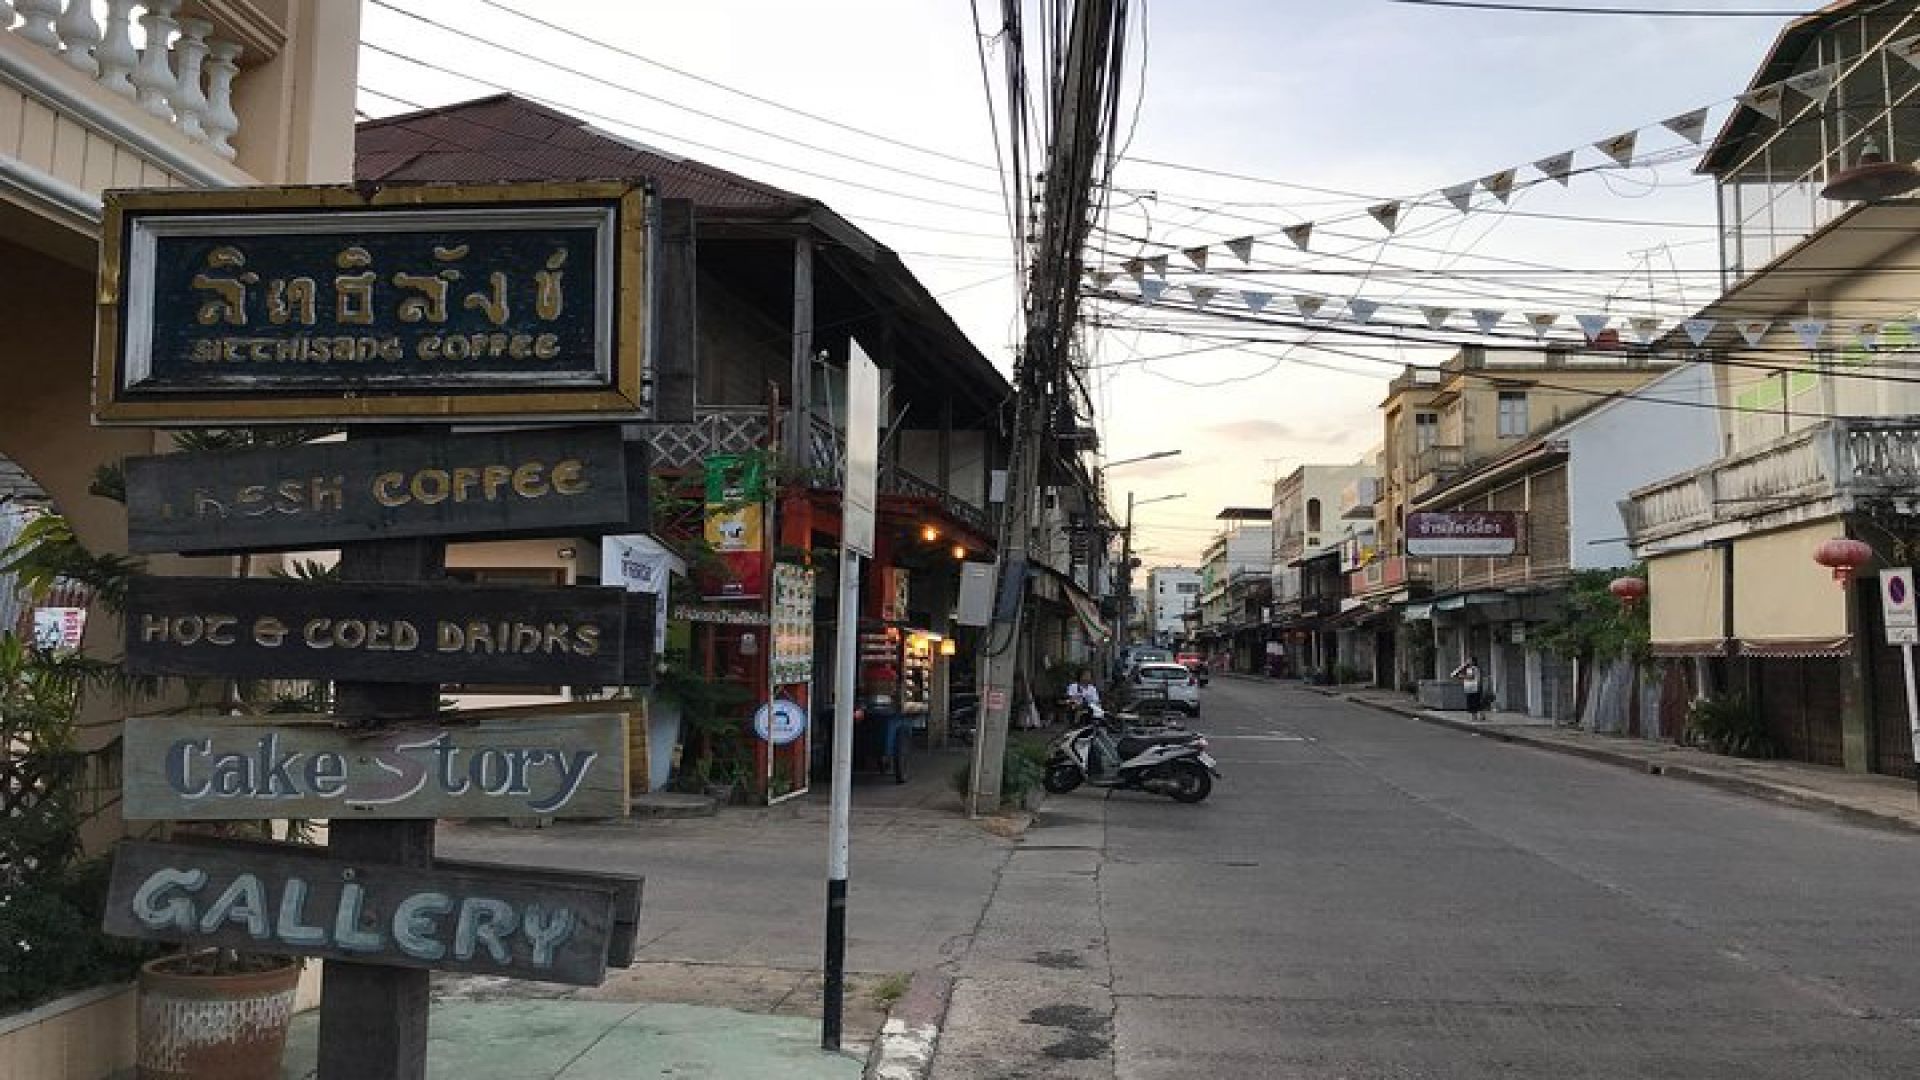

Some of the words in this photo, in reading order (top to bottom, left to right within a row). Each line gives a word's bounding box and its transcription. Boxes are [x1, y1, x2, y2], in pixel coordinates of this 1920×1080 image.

[416, 332, 562, 361] COFFEE
[159, 474, 344, 521] RESH
[371, 458, 592, 508] COFFEE
[139, 613, 239, 647] HOT
[252, 616, 290, 648] &
[302, 617, 420, 652] COLD
[436, 618, 602, 657] DRINKS
[164, 731, 349, 801] Cake
[343, 731, 598, 813] Story
[131, 867, 578, 966] GALLERY
